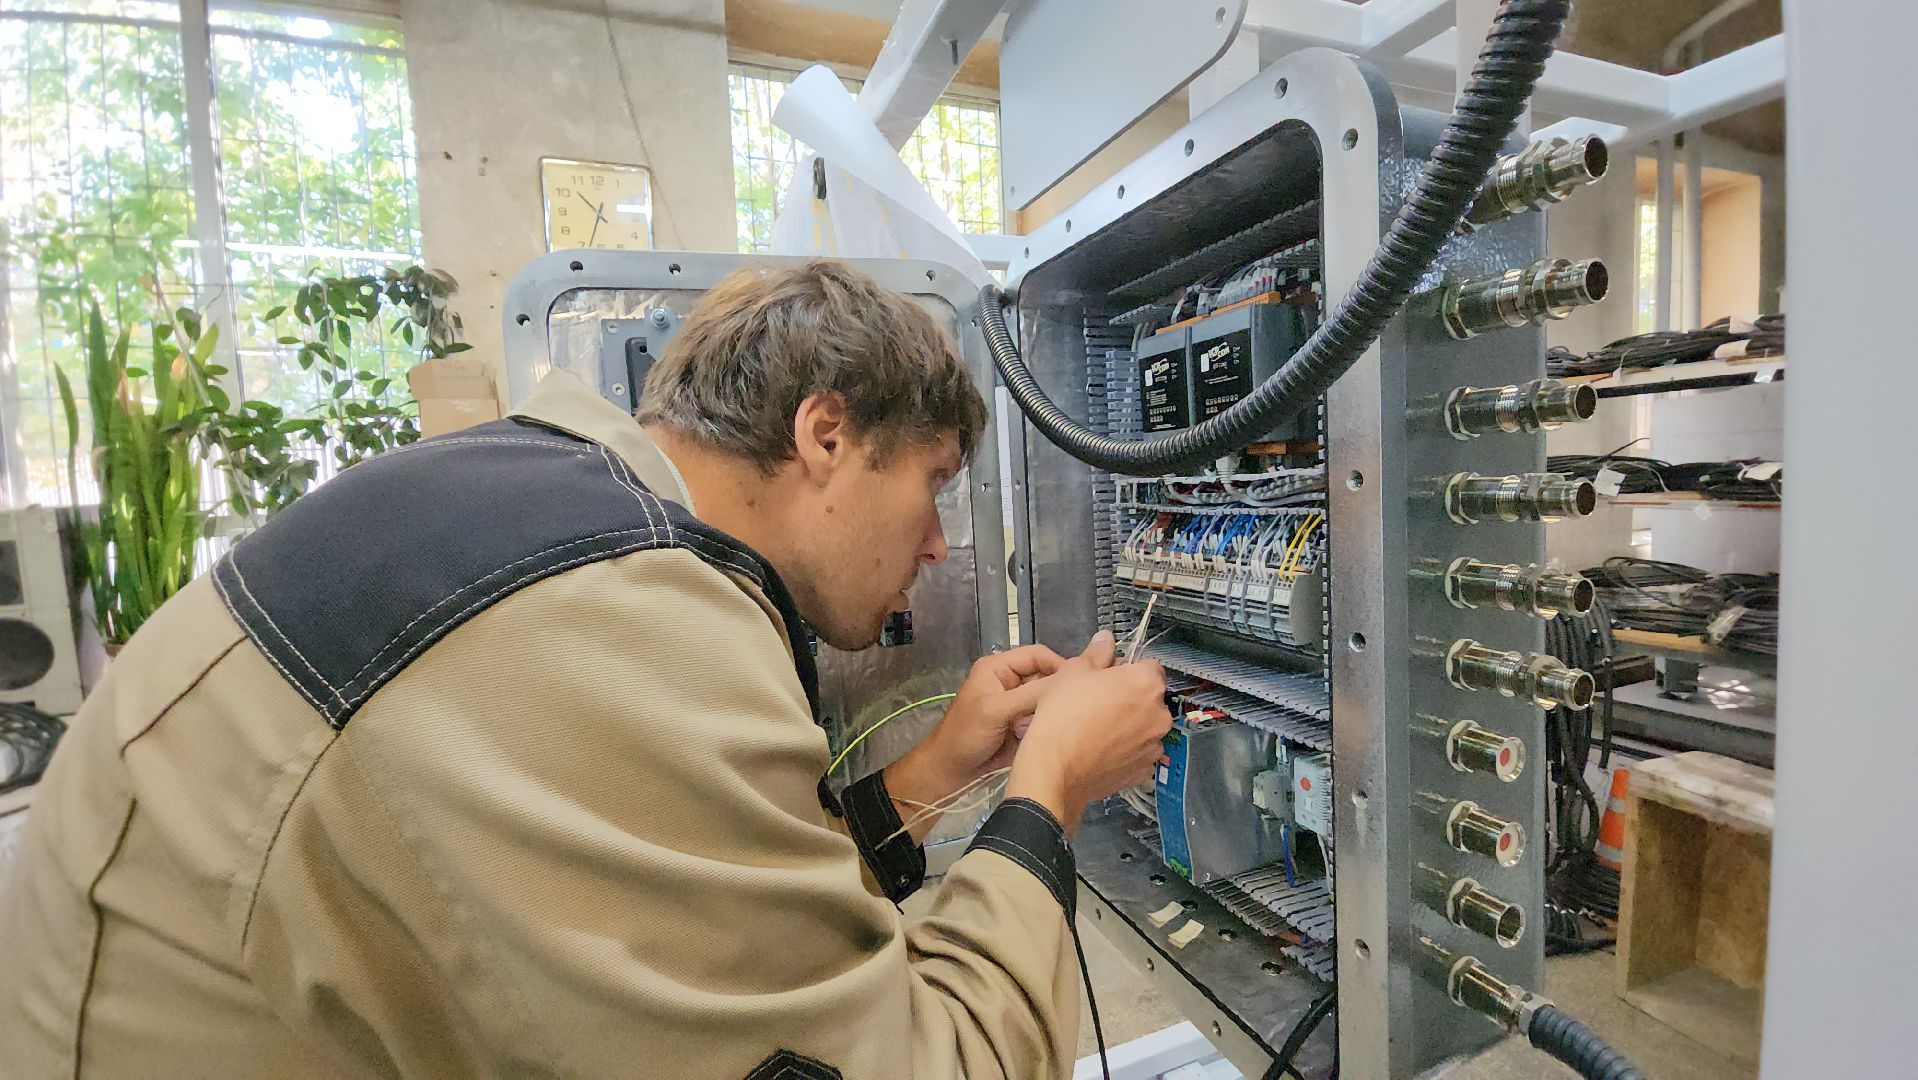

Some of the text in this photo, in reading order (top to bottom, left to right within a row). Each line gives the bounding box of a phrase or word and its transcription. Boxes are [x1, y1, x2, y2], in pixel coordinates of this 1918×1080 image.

[571, 175, 584, 185] 11
[590, 175, 605, 186] 12
[556, 187, 571, 198] 10
[558, 207, 567, 216] 9
[560, 226, 571, 235] 8
[630, 231, 639, 240] 4
